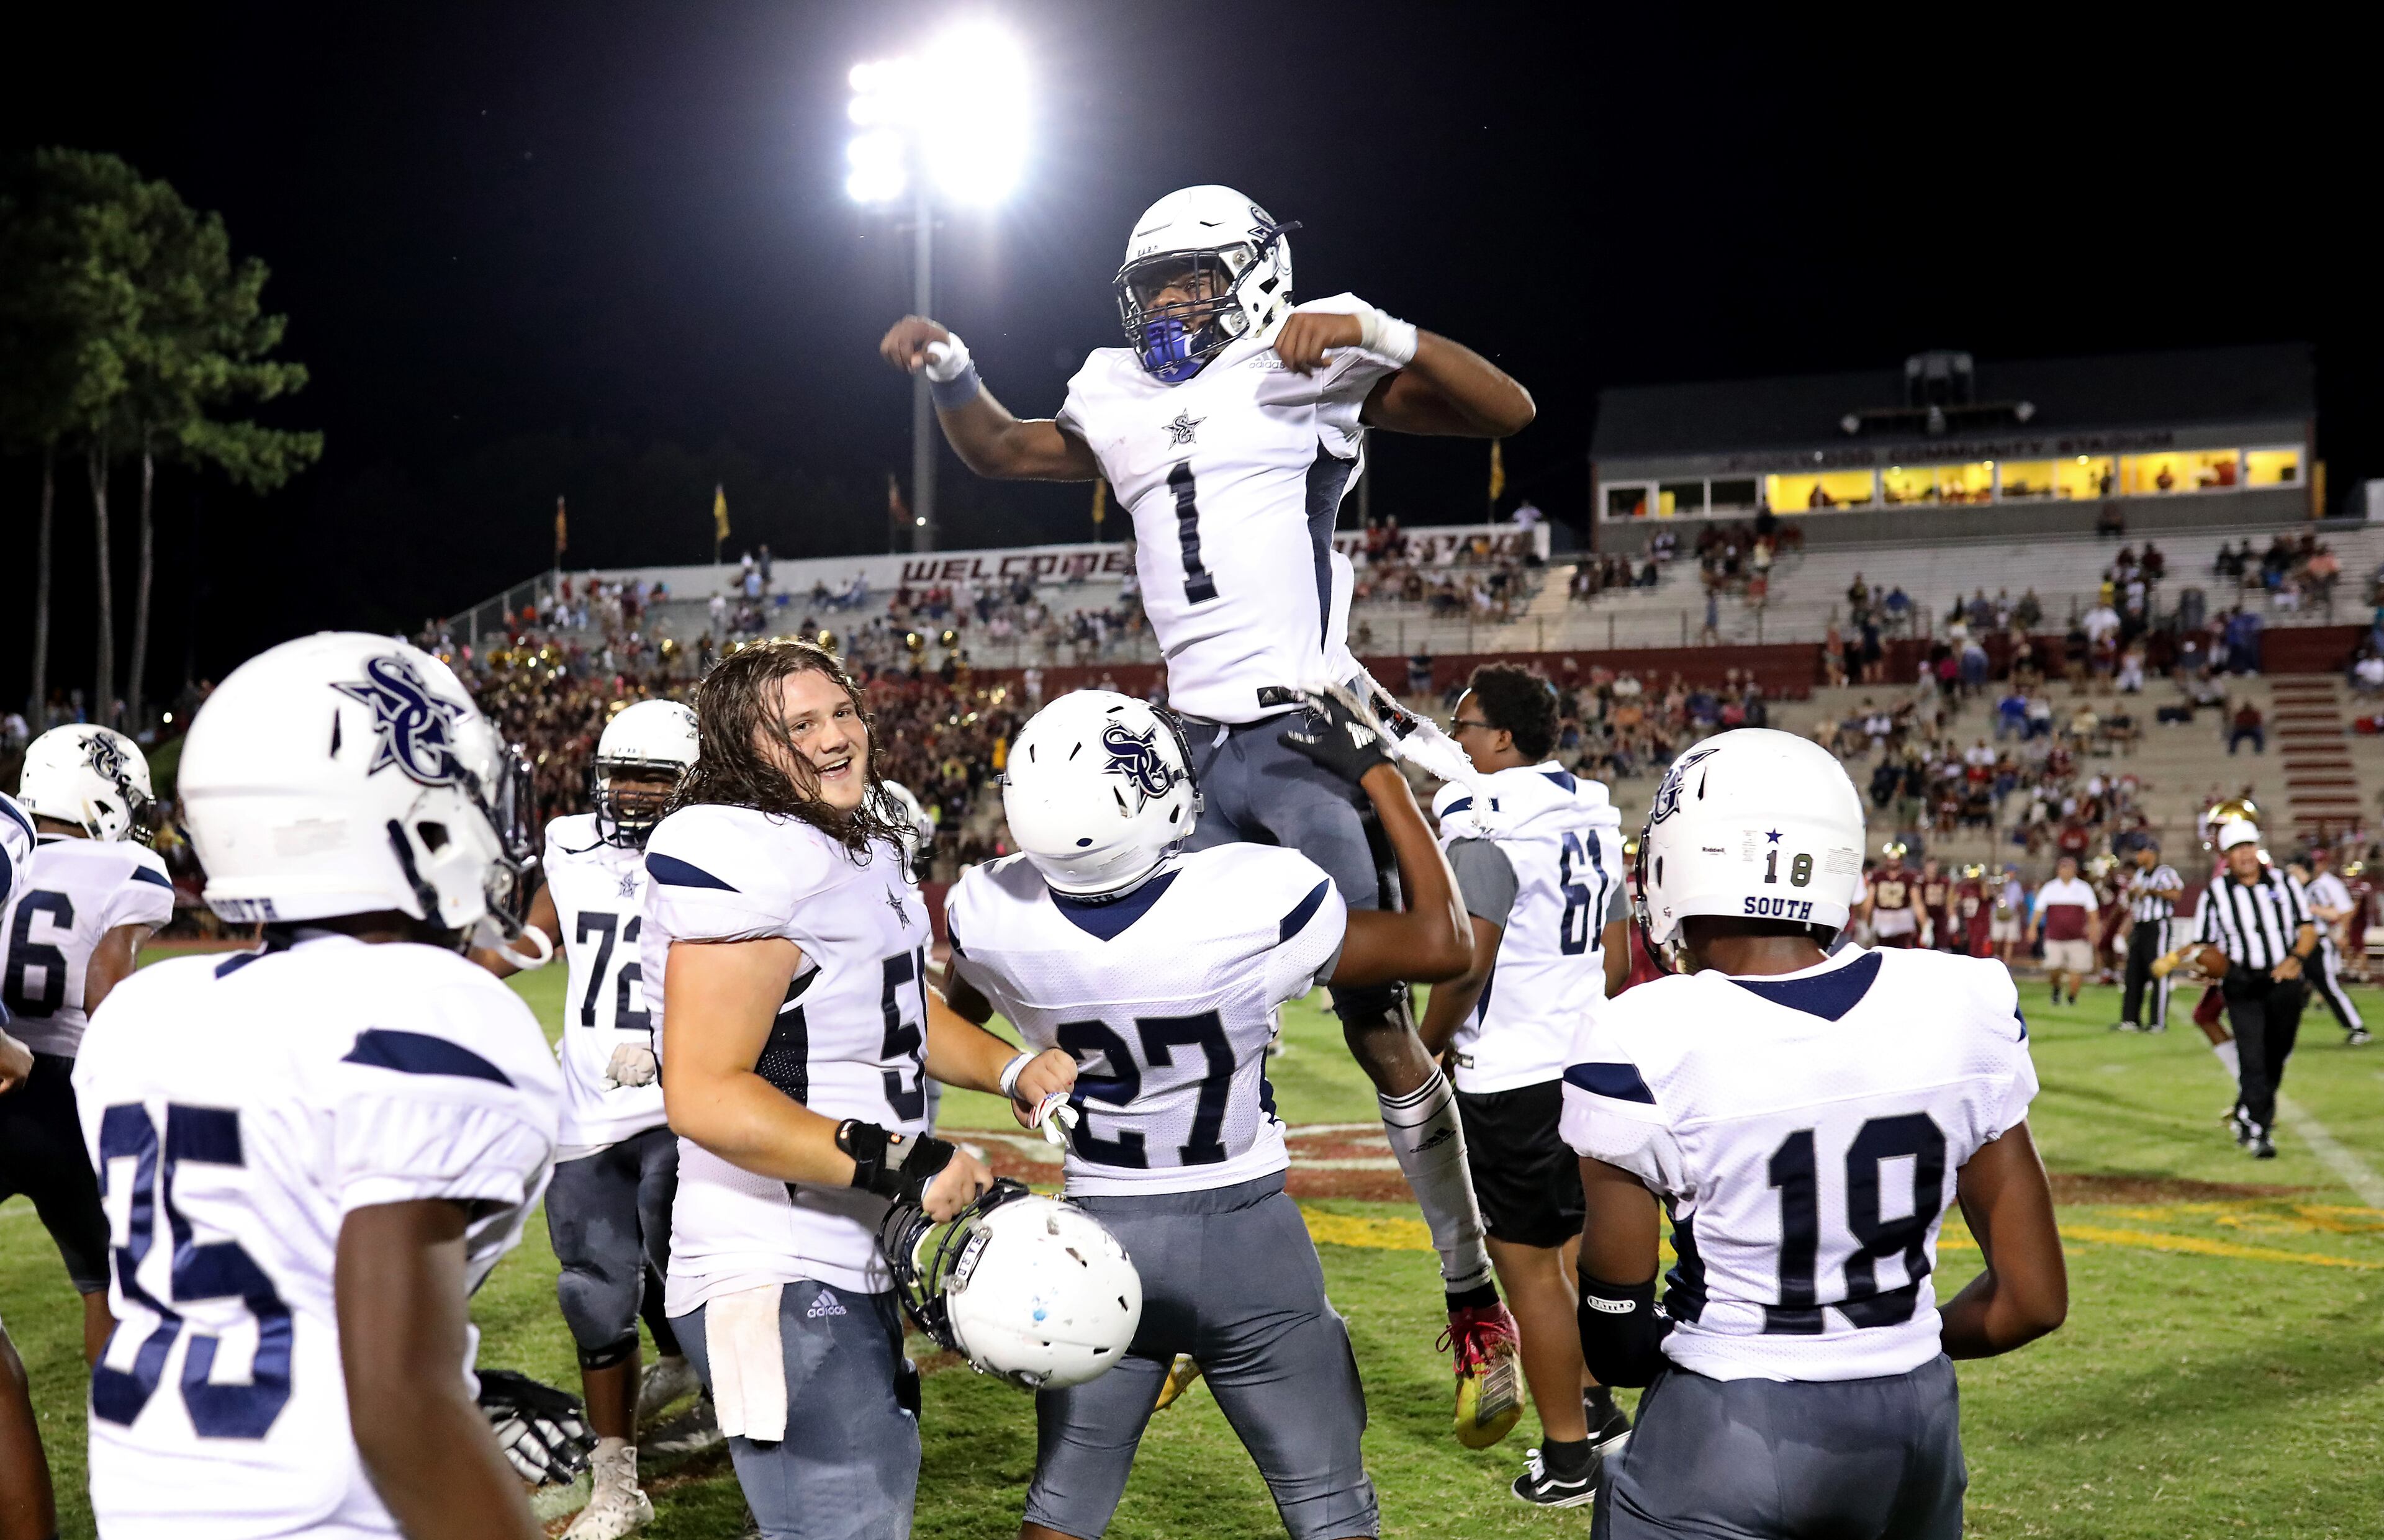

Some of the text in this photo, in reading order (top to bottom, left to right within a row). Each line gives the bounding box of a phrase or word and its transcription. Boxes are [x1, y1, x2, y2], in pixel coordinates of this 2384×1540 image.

[901, 551, 1127, 581] WELCOME
[1167, 461, 1220, 606] 1
[2, 889, 74, 1018] 6
[1560, 829, 1609, 955] 61
[1744, 896, 1813, 920] SOUTH
[576, 911, 651, 1030] 72
[880, 945, 928, 1122] 5
[1057, 1008, 1235, 1169] 27
[93, 1100, 295, 1442] 35
[1763, 1110, 1947, 1335] 18
[807, 1305, 846, 1318] adidas
